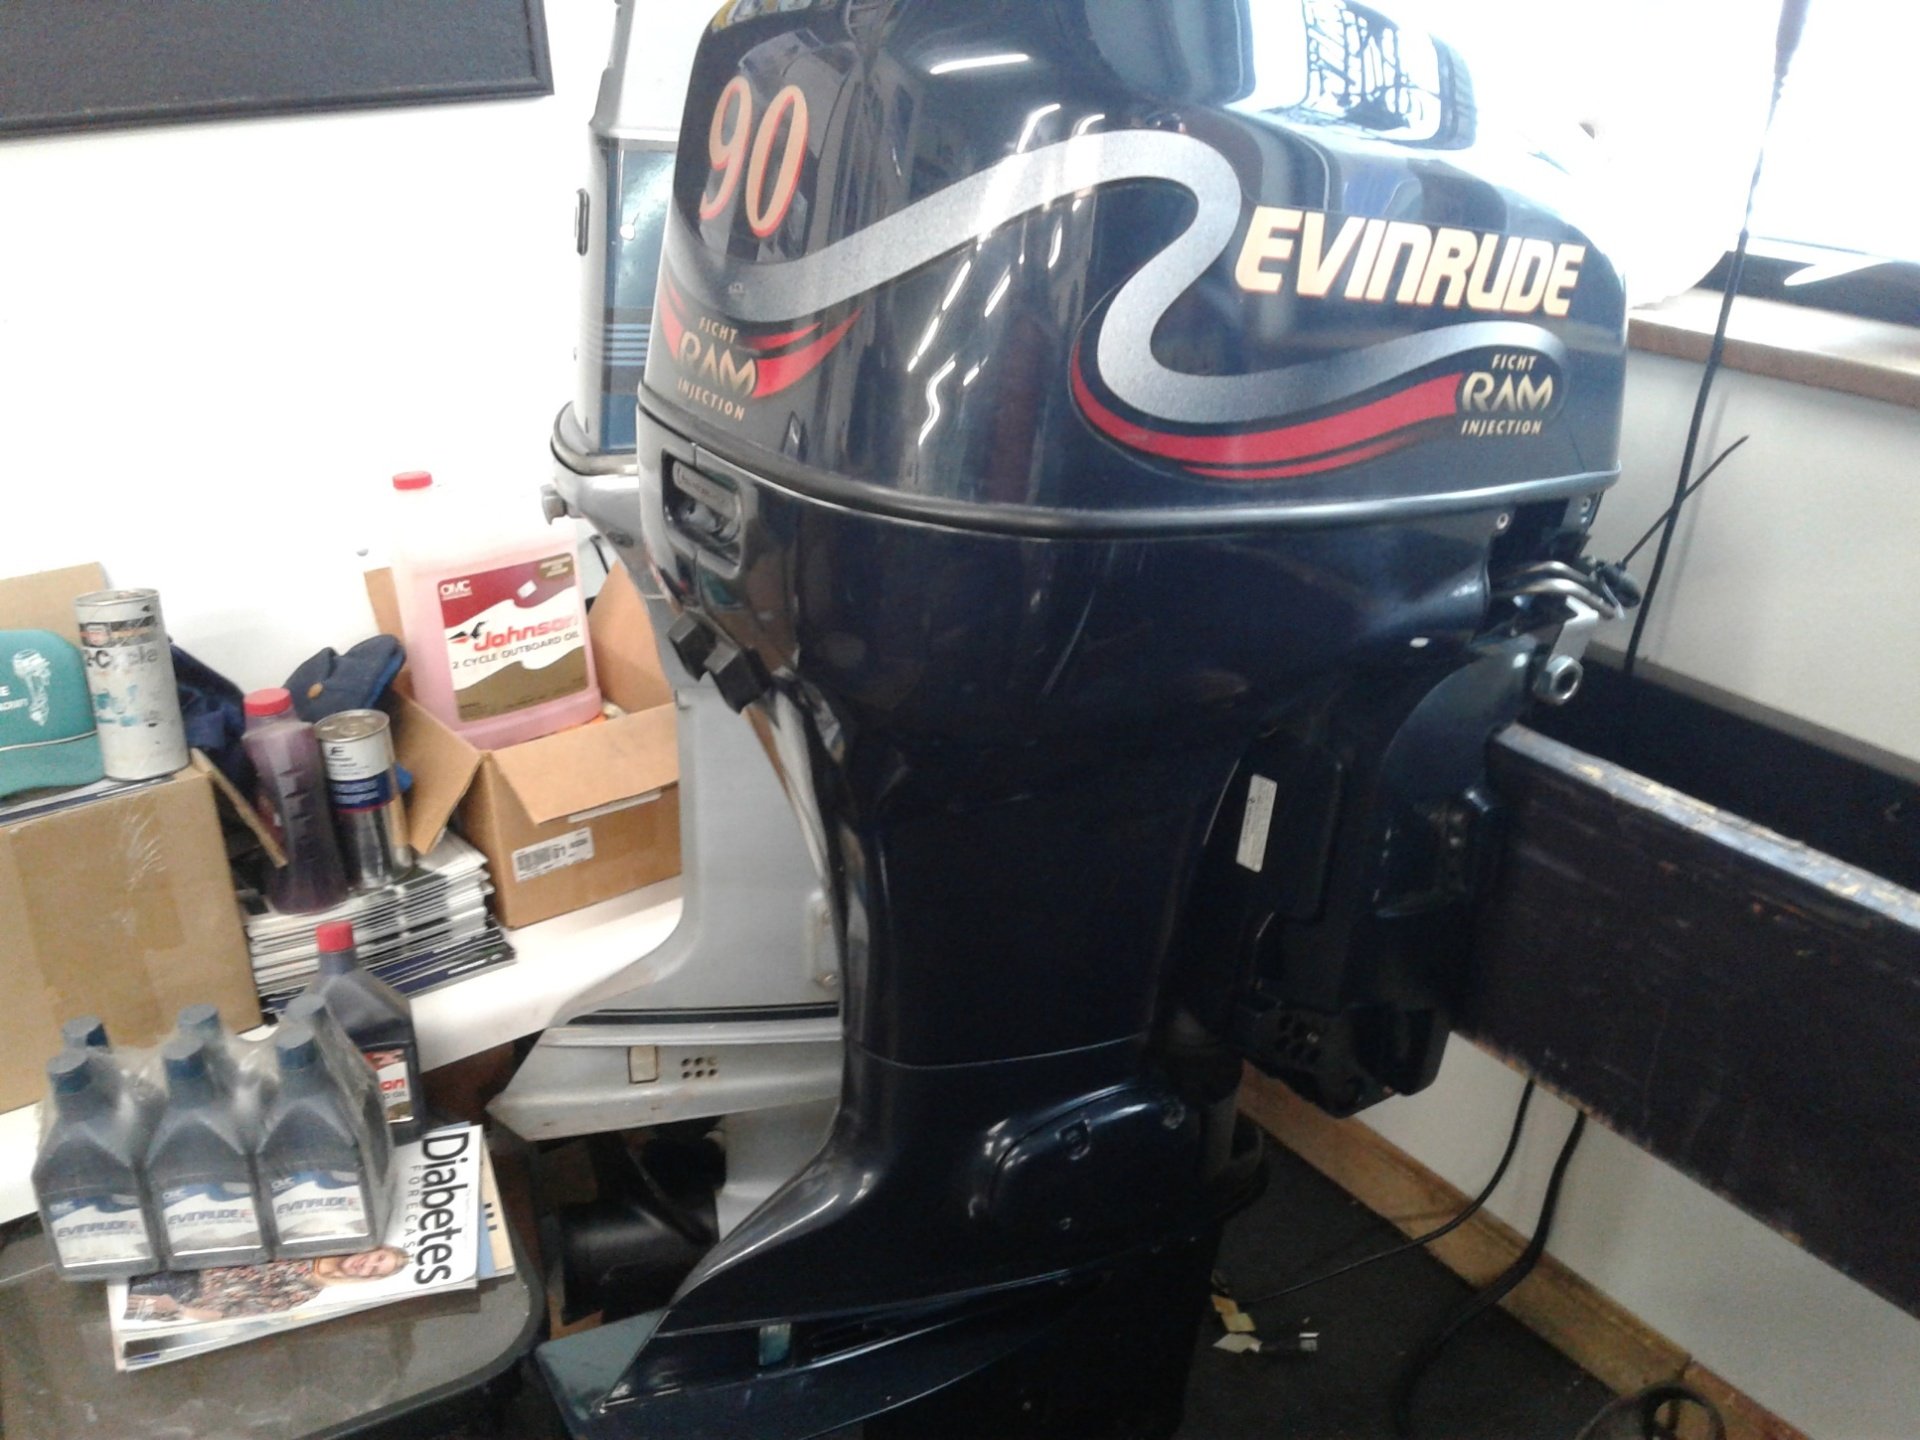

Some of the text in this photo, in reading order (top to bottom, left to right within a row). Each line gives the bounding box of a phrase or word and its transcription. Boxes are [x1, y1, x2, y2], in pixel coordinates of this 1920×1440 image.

[699, 75, 808, 238] 90
[1234, 205, 1587, 317] EVINRUDE
[699, 317, 738, 344] FICHT
[1491, 353, 1537, 371] FICHT
[678, 377, 745, 421] INJECTION
[1462, 372, 1554, 411] RAM
[1461, 419, 1542, 436] INJECTION
[440, 581, 471, 596] OMC
[463, 653, 497, 667] CYCLE
[502, 636, 562, 659] OUTBOARD
[563, 631, 579, 642] OIL
[474, 617, 578, 652] Johnson
[414, 1132, 469, 1285] Diabetes
